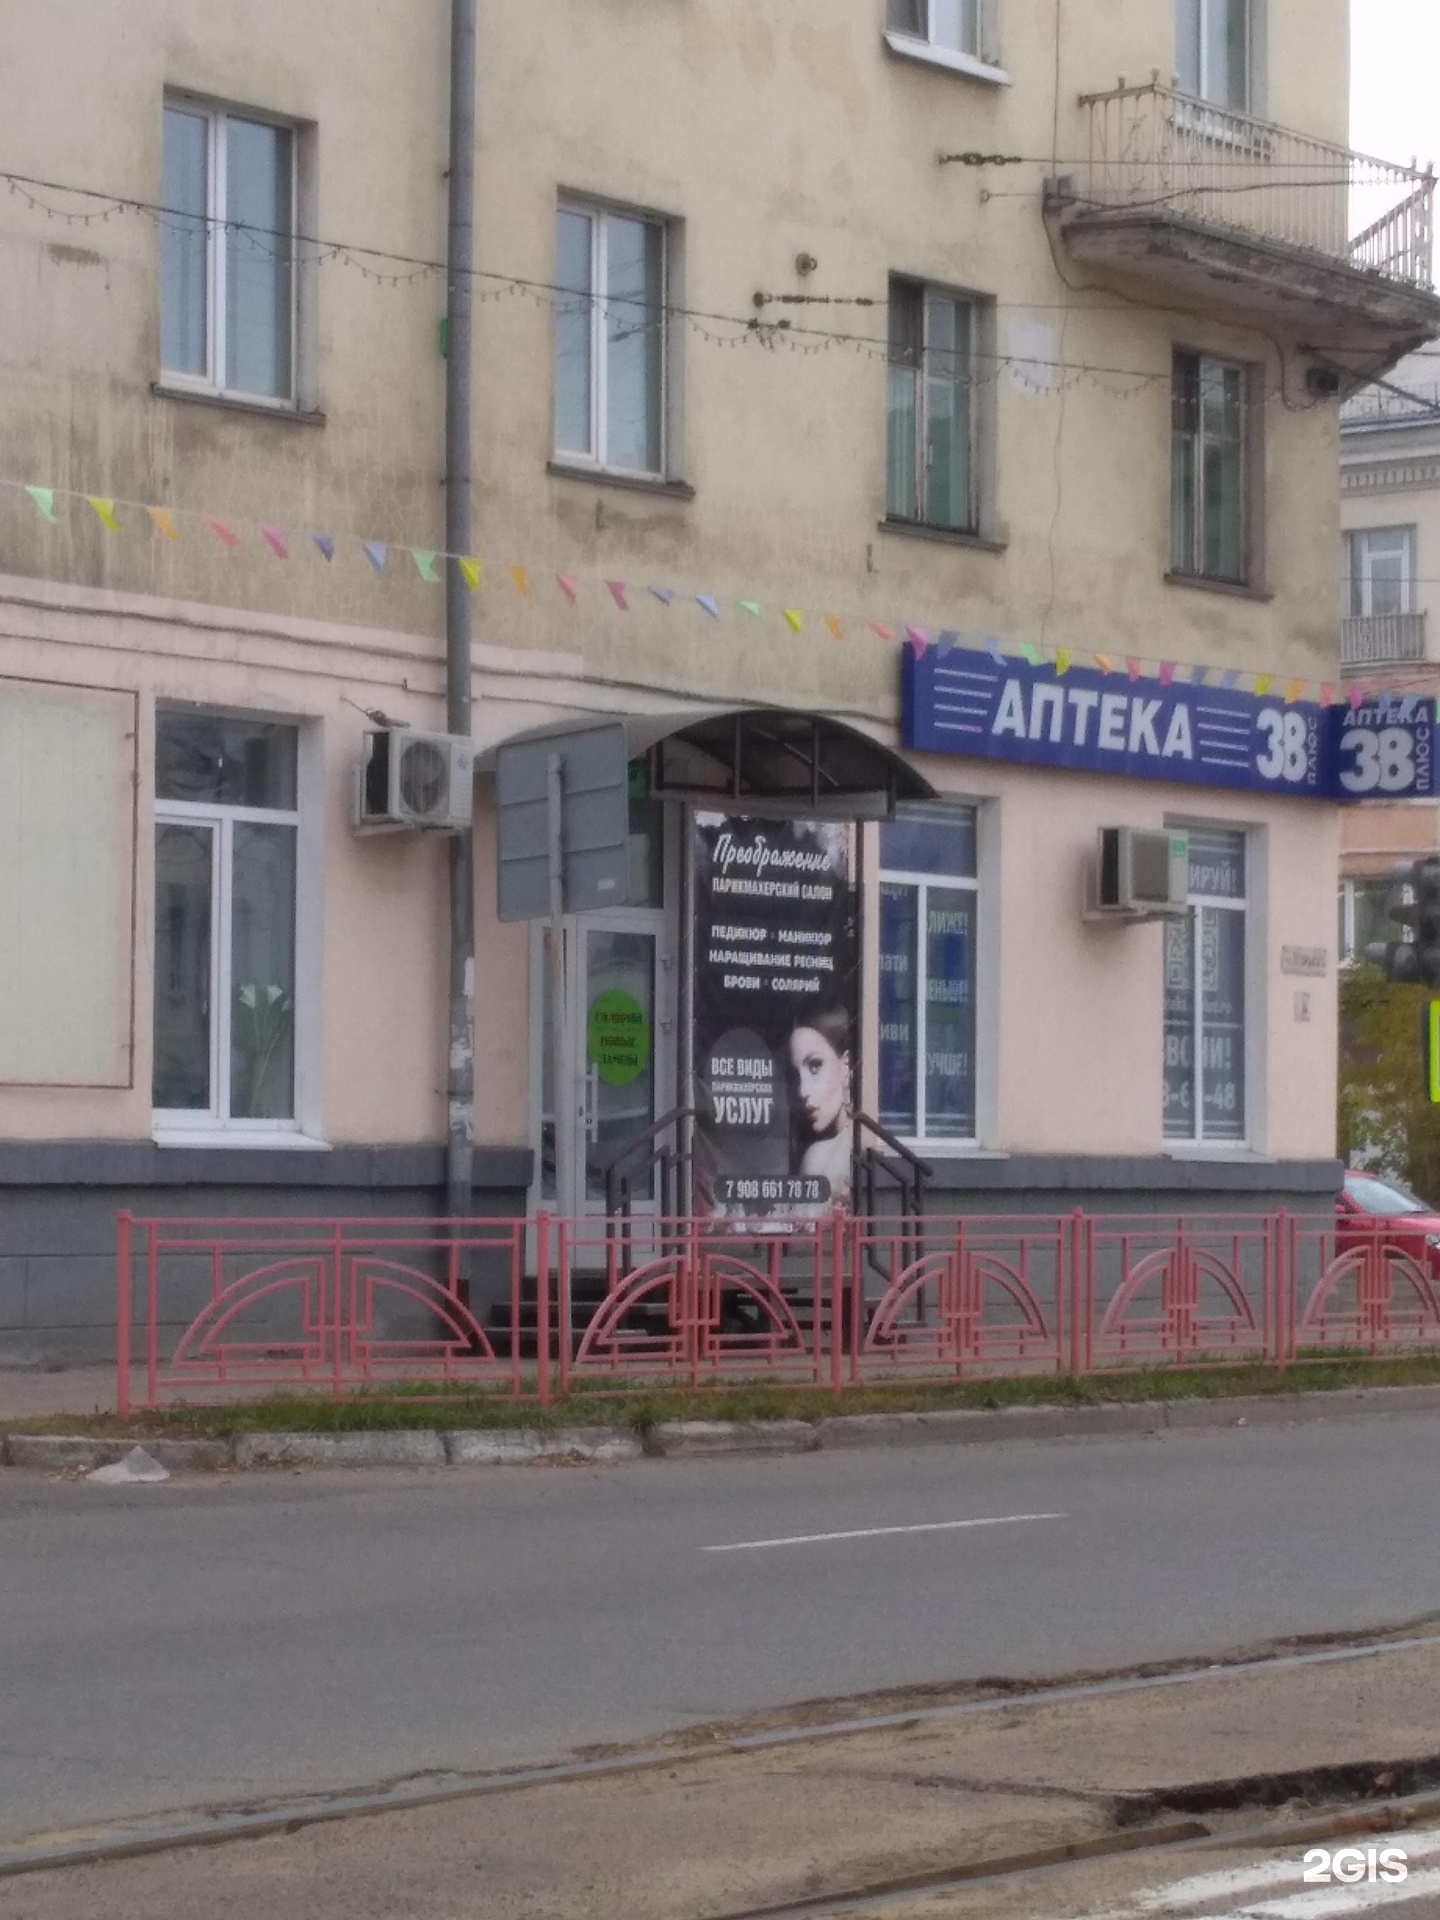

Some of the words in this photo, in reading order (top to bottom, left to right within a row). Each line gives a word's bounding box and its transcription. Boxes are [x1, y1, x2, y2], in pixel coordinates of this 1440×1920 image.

[1342, 705, 1429, 726] АПТЕКА
[993, 679, 1194, 760] АПТЕКА
[1256, 708, 1308, 783] 38
[1339, 727, 1415, 791] 38
[1416, 725, 1430, 790] ПЛЮС
[713, 833, 832, 877] Преображение
[713, 877, 799, 898] ПАРИКМАХЕРСКИЙ
[801, 884, 833, 900] САЛОН
[711, 925, 768, 941] ПЕДИКЮР
[778, 929, 832, 944] МАНИКЮР
[709, 949, 791, 967] НАРАЩИВАНИЕ
[793, 954, 834, 971] РЕСНИЦ
[724, 975, 760, 989] БРОВИ
[771, 976, 820, 992] СОЛЯРИЙ
[711, 1057, 734, 1076] ВСЕ
[737, 1058, 773, 1080] ВИДЫ
[713, 1096, 774, 1125] УСЛУГ
[725, 1179, 734, 1198] 7
